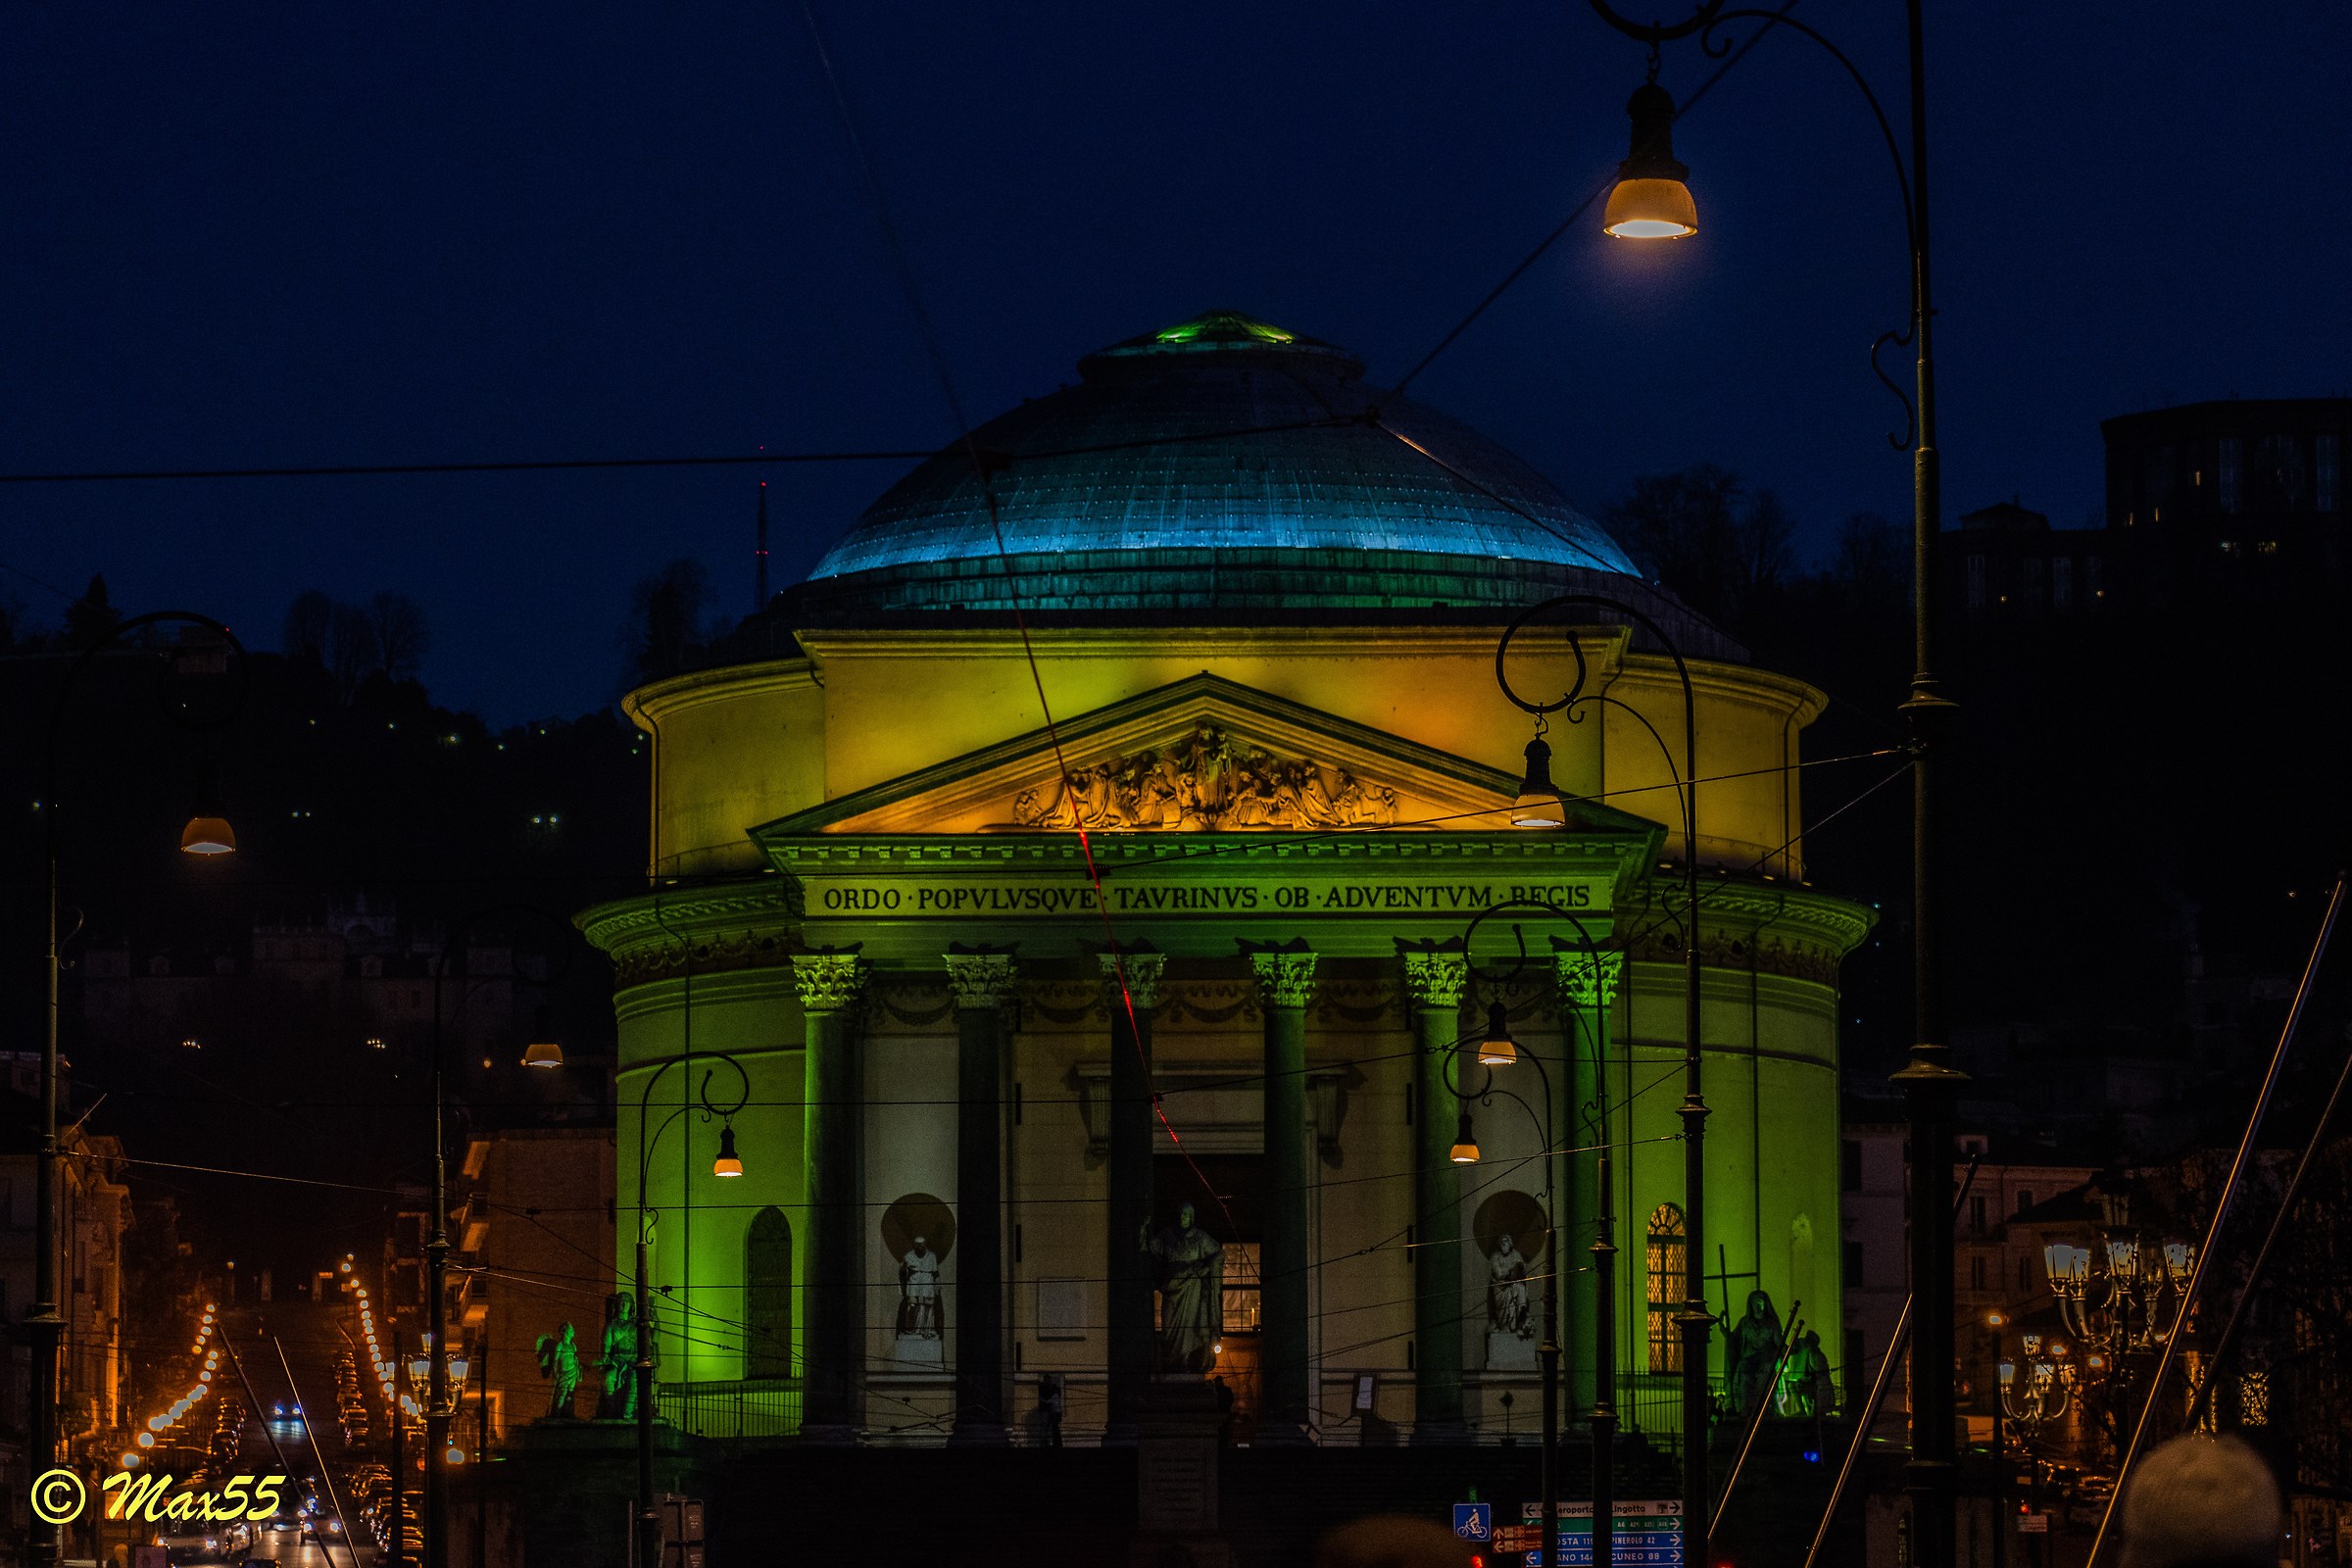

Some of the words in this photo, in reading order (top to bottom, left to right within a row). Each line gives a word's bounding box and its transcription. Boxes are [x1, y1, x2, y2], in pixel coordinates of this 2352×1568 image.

[823, 888, 901, 909] ORDO
[917, 887, 1098, 912] POPVLVSQVE
[1113, 886, 1258, 908] TAVRINVS
[1274, 886, 1309, 907] OB
[1323, 885, 1493, 907] ADVENTVM
[1511, 885, 1591, 906] REGIS
[1556, 1505, 1594, 1515] eroporto
[1611, 1552, 1644, 1561] CUNEO
